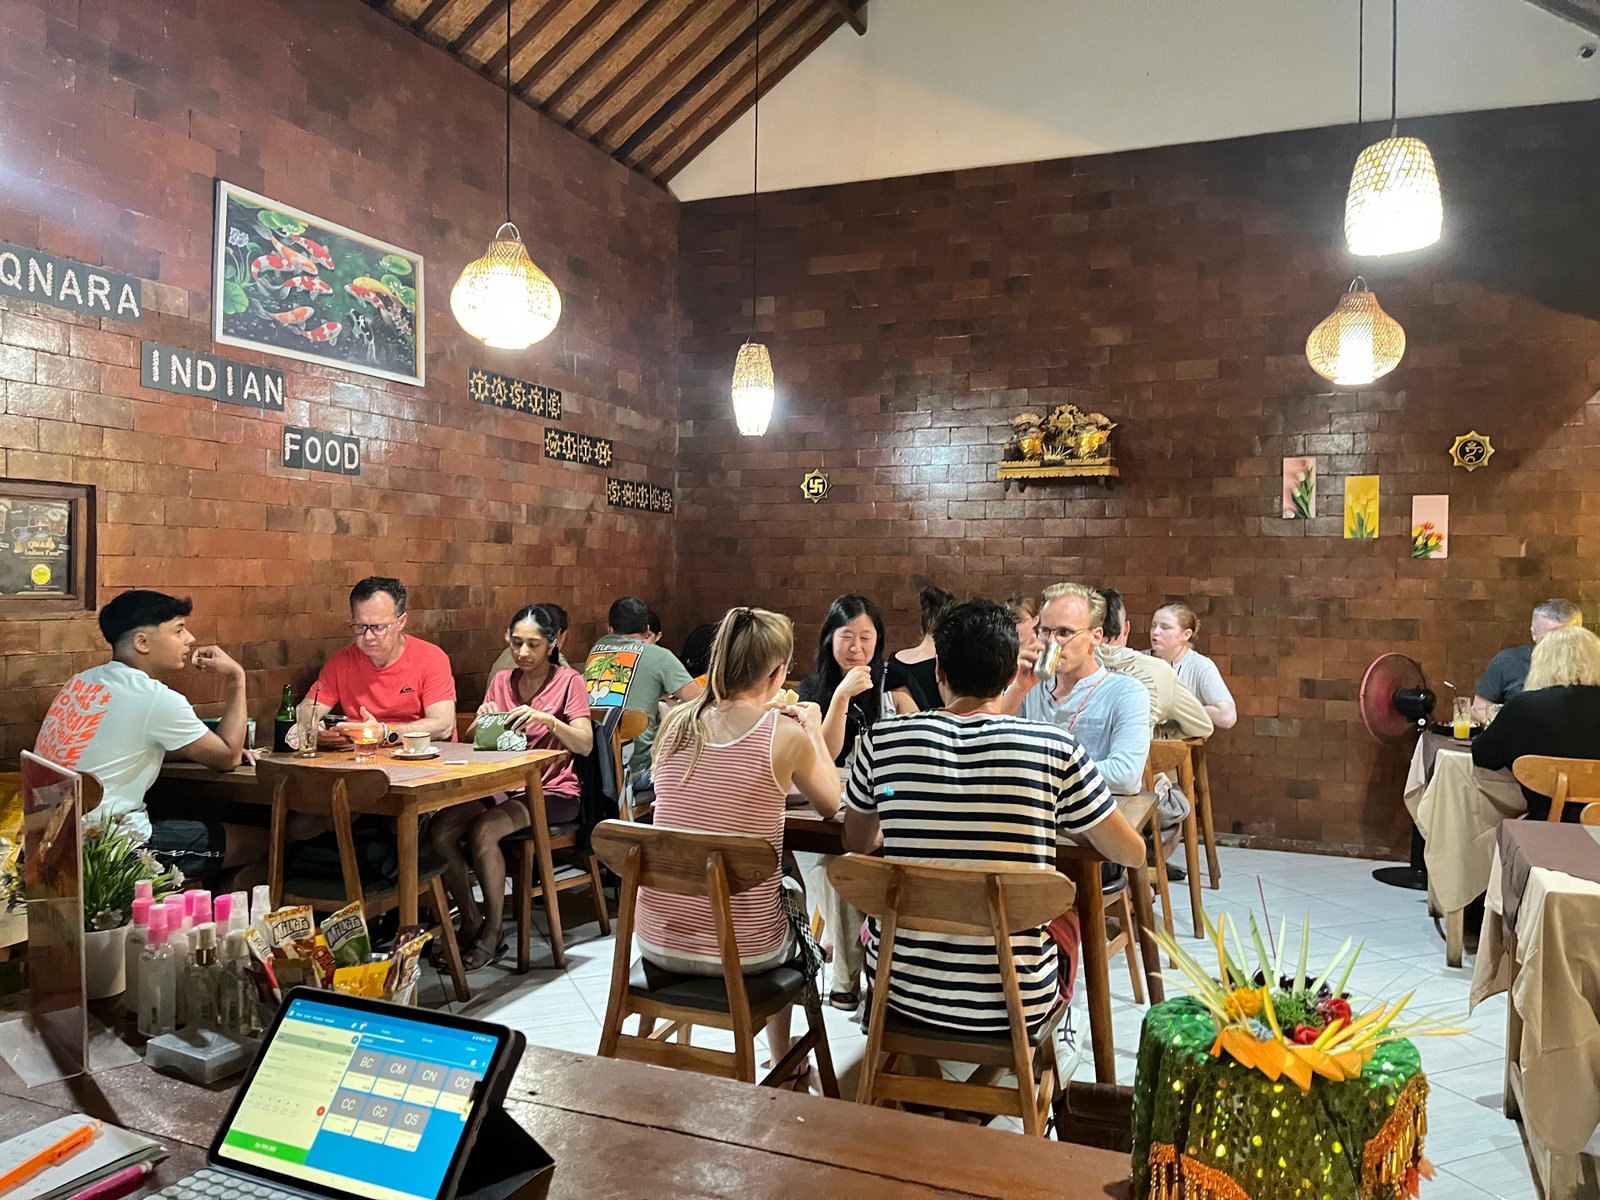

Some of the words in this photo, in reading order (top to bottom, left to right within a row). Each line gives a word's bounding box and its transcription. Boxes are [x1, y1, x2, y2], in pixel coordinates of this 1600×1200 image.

[0, 252, 141, 318] QNARA
[152, 349, 284, 406] INDIAN
[472, 375, 559, 414] TASTE
[284, 431, 360, 470] FOOD
[547, 434, 609, 463] WITH
[609, 482, 671, 508] SMILE
[360, 1056, 374, 1068] BC
[390, 1063, 407, 1075] CM
[422, 1070, 437, 1082] CN
[455, 1077, 469, 1089] CC
[341, 1098, 356, 1111] CC
[372, 1105, 387, 1118] GC
[404, 1113, 419, 1126] QS
